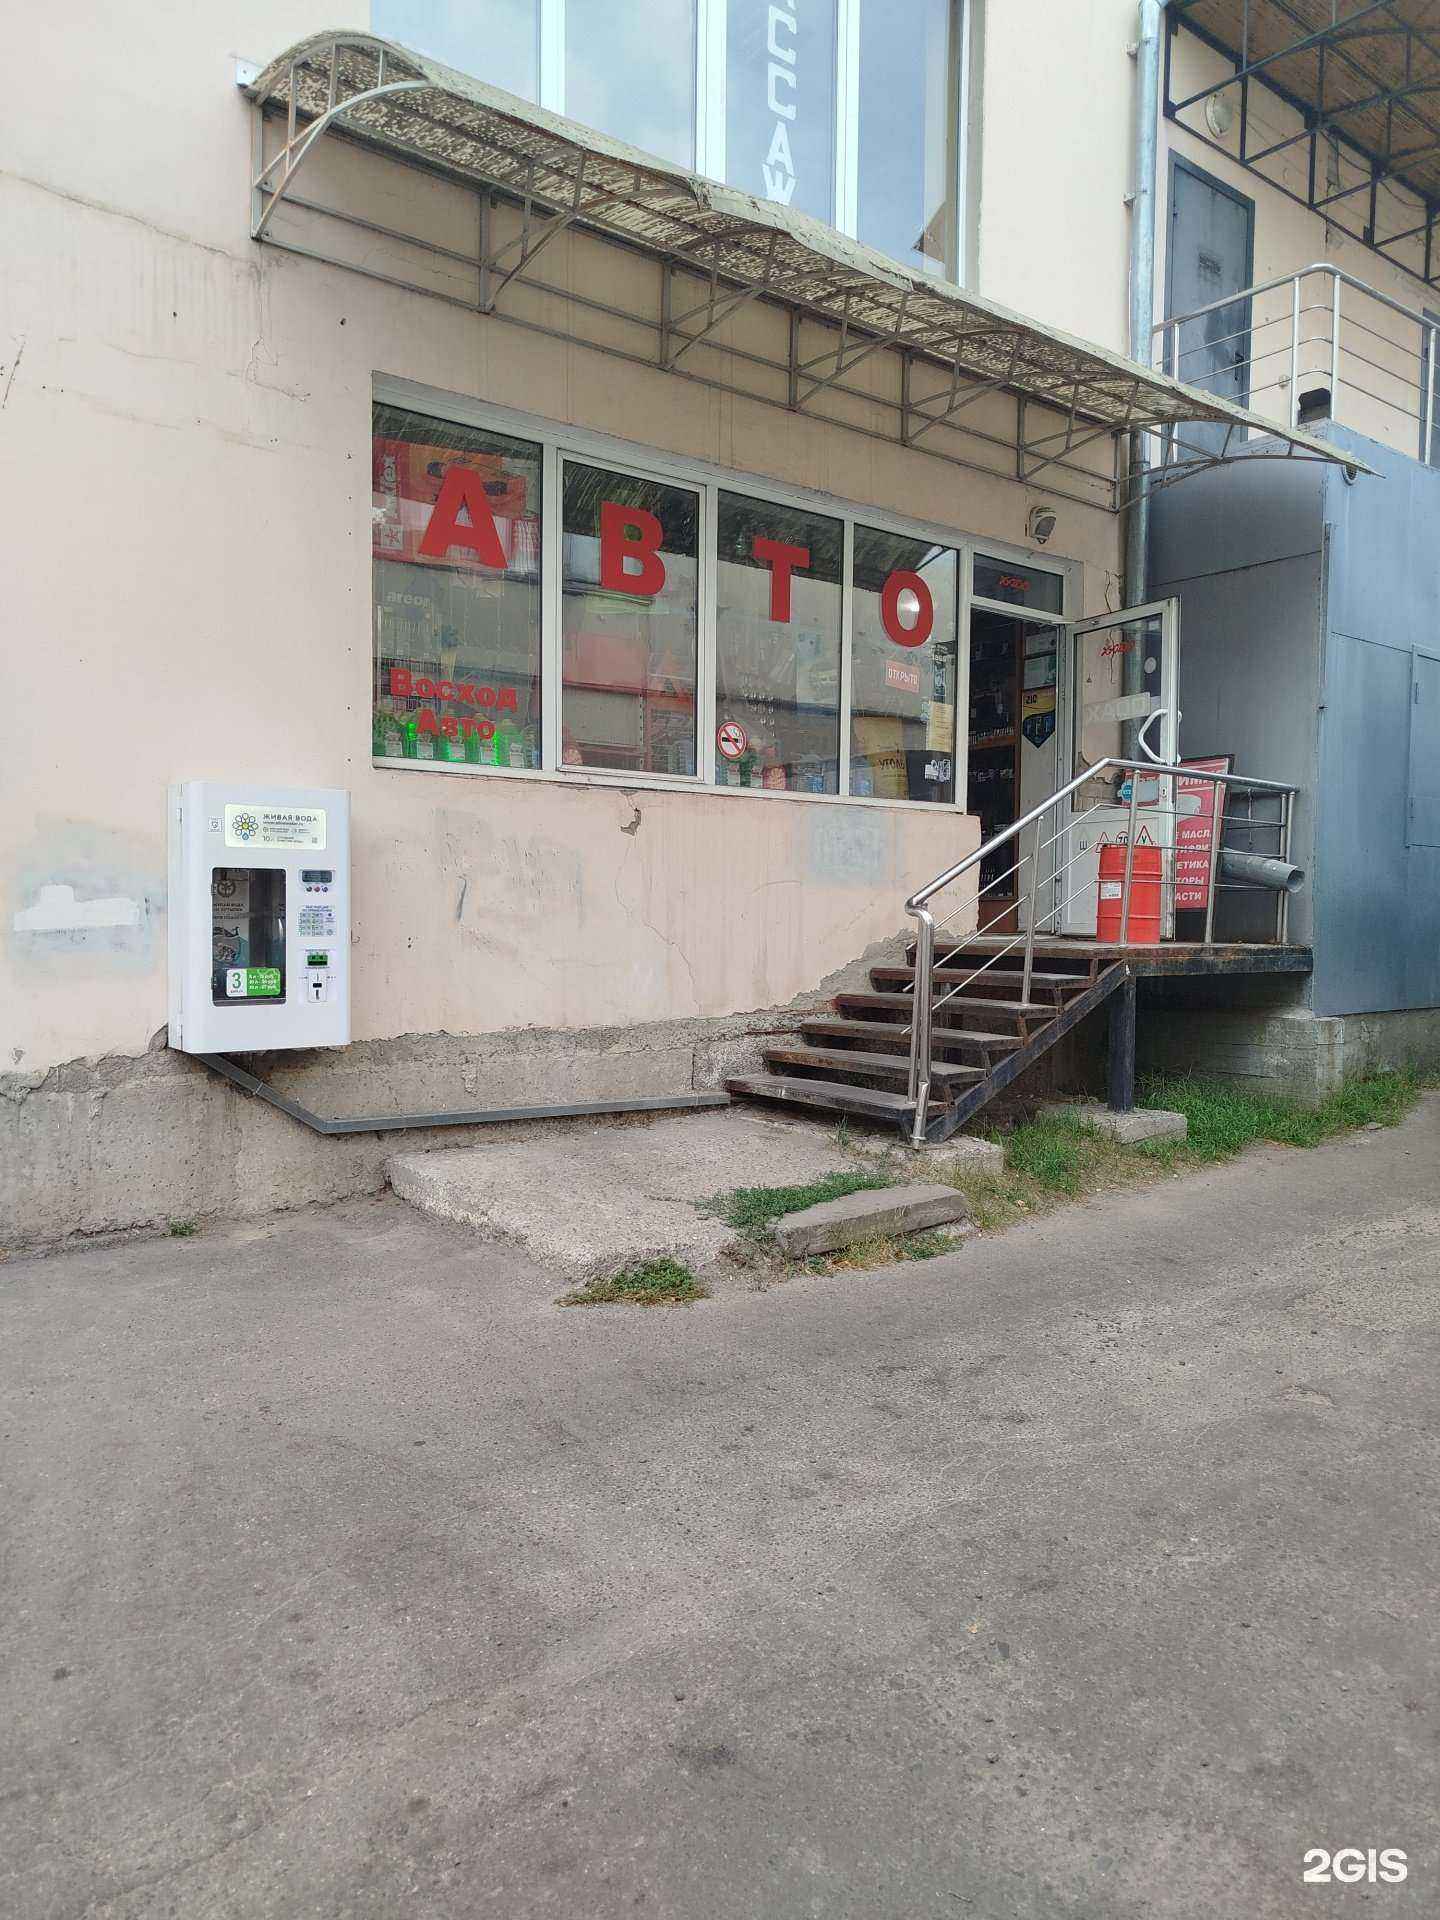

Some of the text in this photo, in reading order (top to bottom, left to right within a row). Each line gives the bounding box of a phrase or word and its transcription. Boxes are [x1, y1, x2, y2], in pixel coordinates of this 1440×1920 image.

[762, 0, 797, 206] ССАЖ
[887, 665, 919, 686] ОТКРЫТО
[389, 667, 518, 713] Восход
[416, 708, 496, 741] Авто
[263, 813, 318, 823] ЖИВАЯ ВОДА
[1181, 829, 1212, 839] МАСЛ
[231, 972, 242, 989] 3
